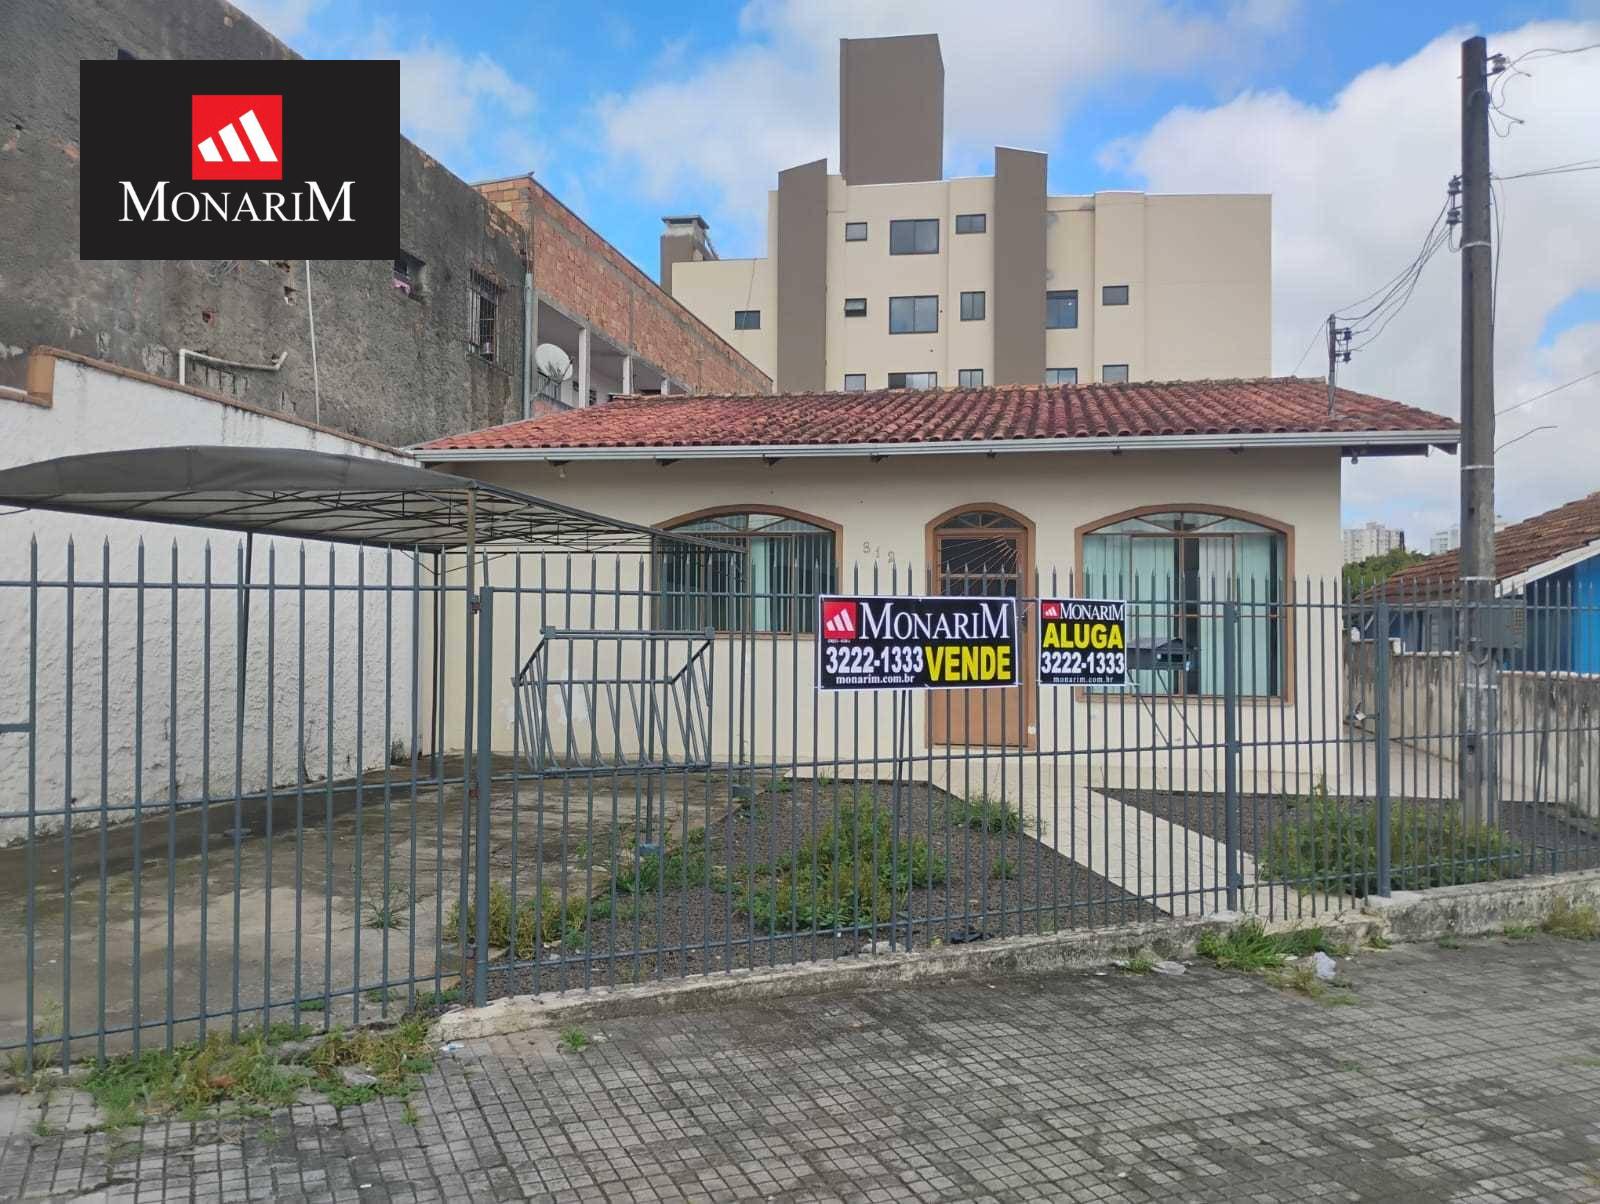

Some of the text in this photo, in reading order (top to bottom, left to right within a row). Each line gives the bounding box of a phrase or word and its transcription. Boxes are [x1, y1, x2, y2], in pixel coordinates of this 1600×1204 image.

[858, 602, 1010, 640] MONARIM
[1060, 603, 1125, 621] MONARIM
[1042, 622, 1124, 649] ALUGA
[826, 646, 923, 674] 3222-1333
[924, 645, 1011, 681] VENDE
[1041, 651, 1125, 674] 3222-1333
[835, 674, 915, 684] monarim.com.br
